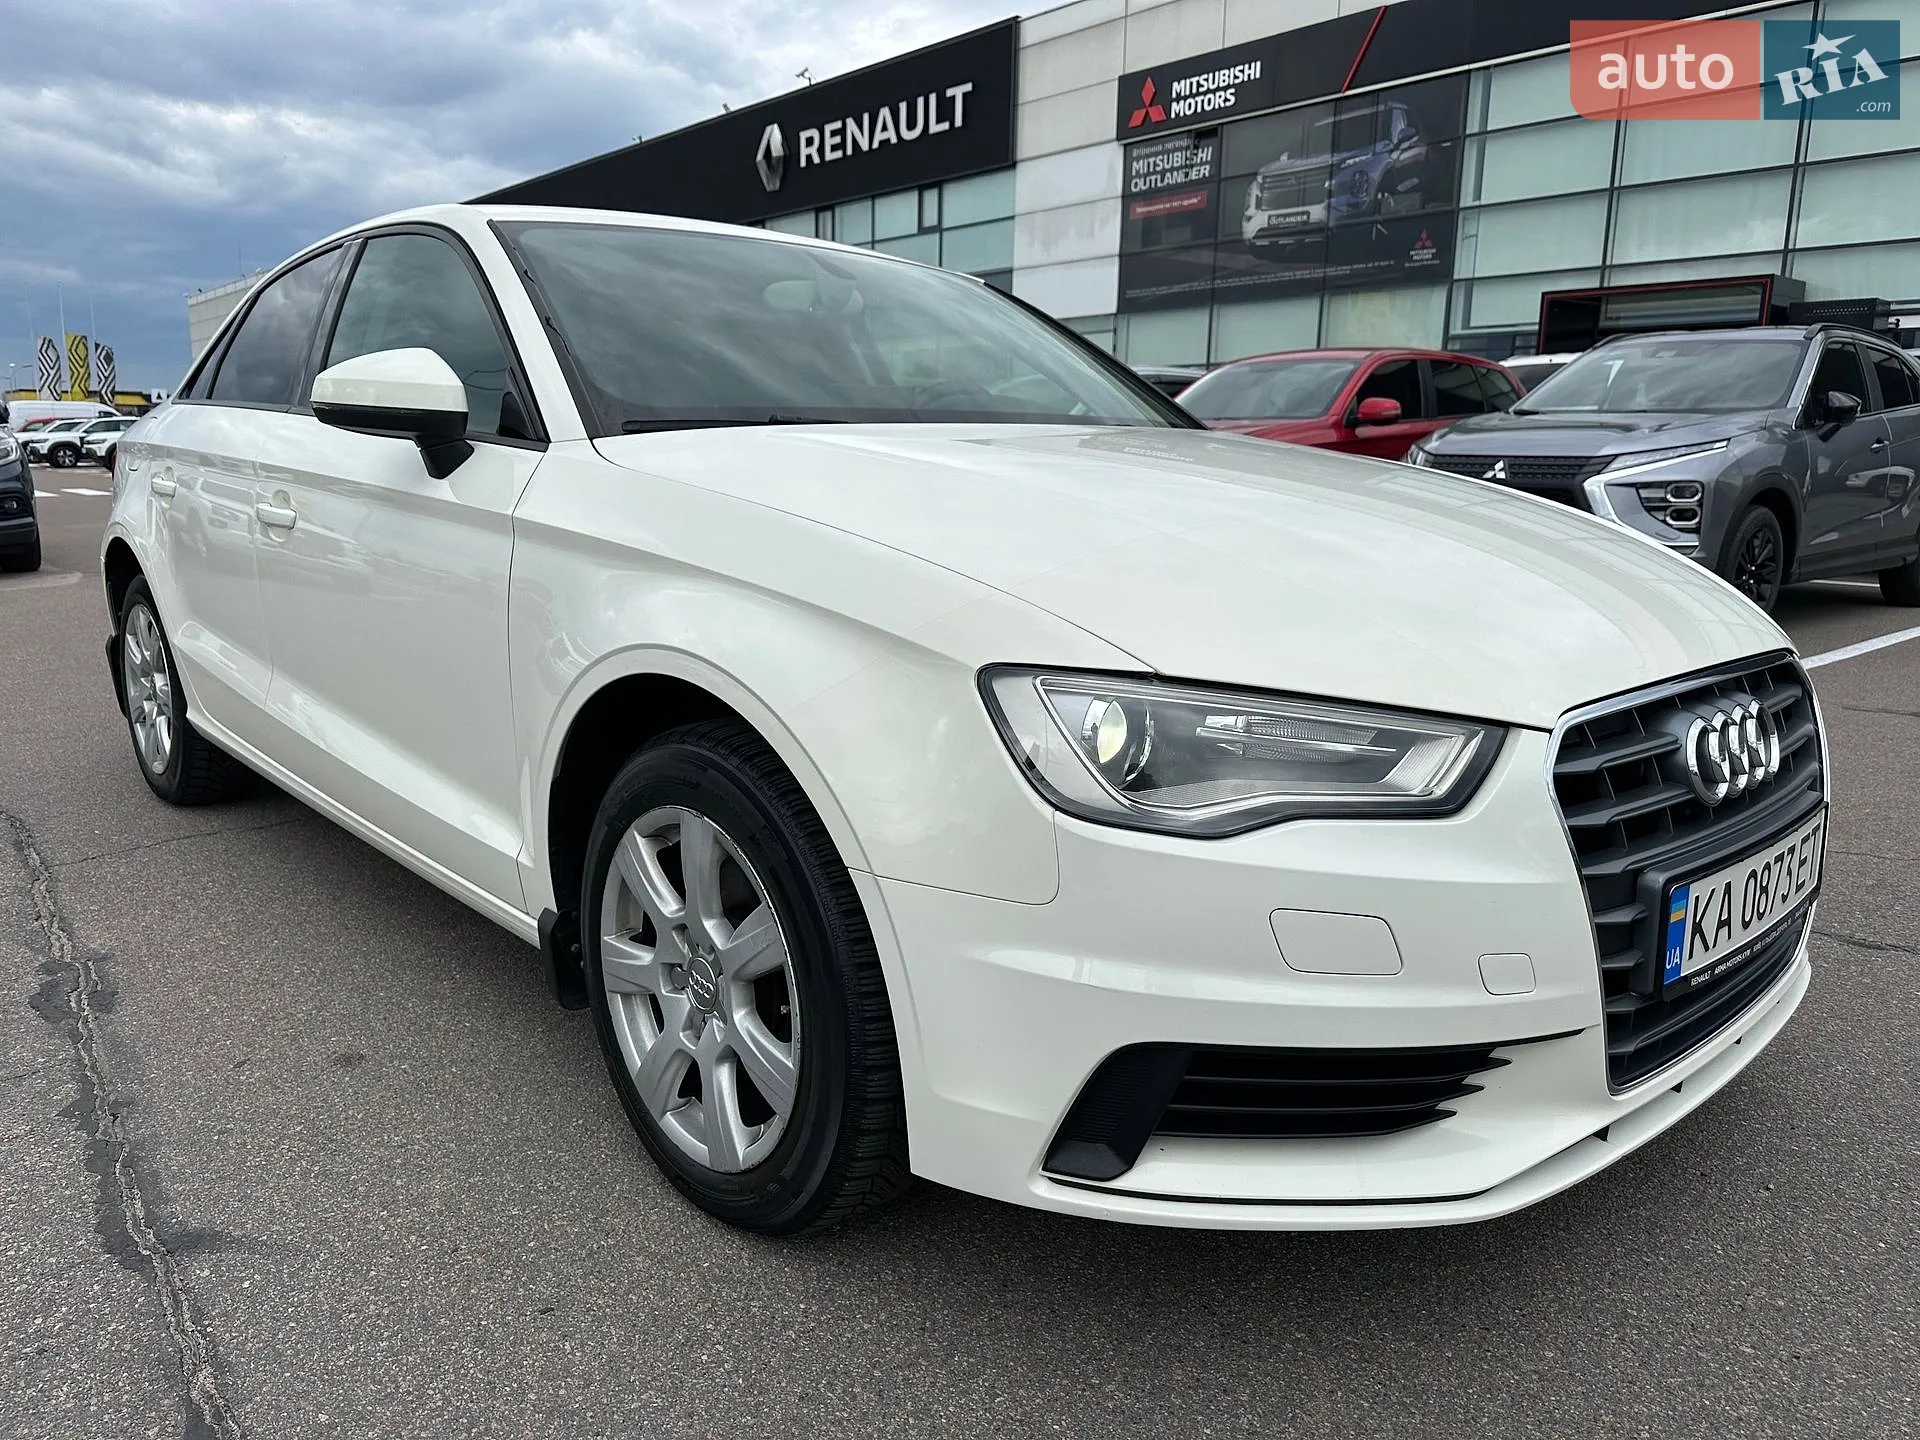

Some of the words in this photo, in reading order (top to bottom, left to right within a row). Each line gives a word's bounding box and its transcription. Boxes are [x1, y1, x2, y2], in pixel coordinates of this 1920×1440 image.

[1171, 61, 1261, 98] MITSUBISHI
[1170, 88, 1236, 119] MOTORS
[799, 82, 973, 169] RENAULT
[1131, 147, 1213, 176] MITSUBISHI
[1130, 165, 1210, 192] OUTLANDER
[1687, 880, 1732, 961] KA
[1741, 843, 1796, 930] 0873
[1795, 823, 1821, 895] ET
[1665, 947, 1681, 969] UA
